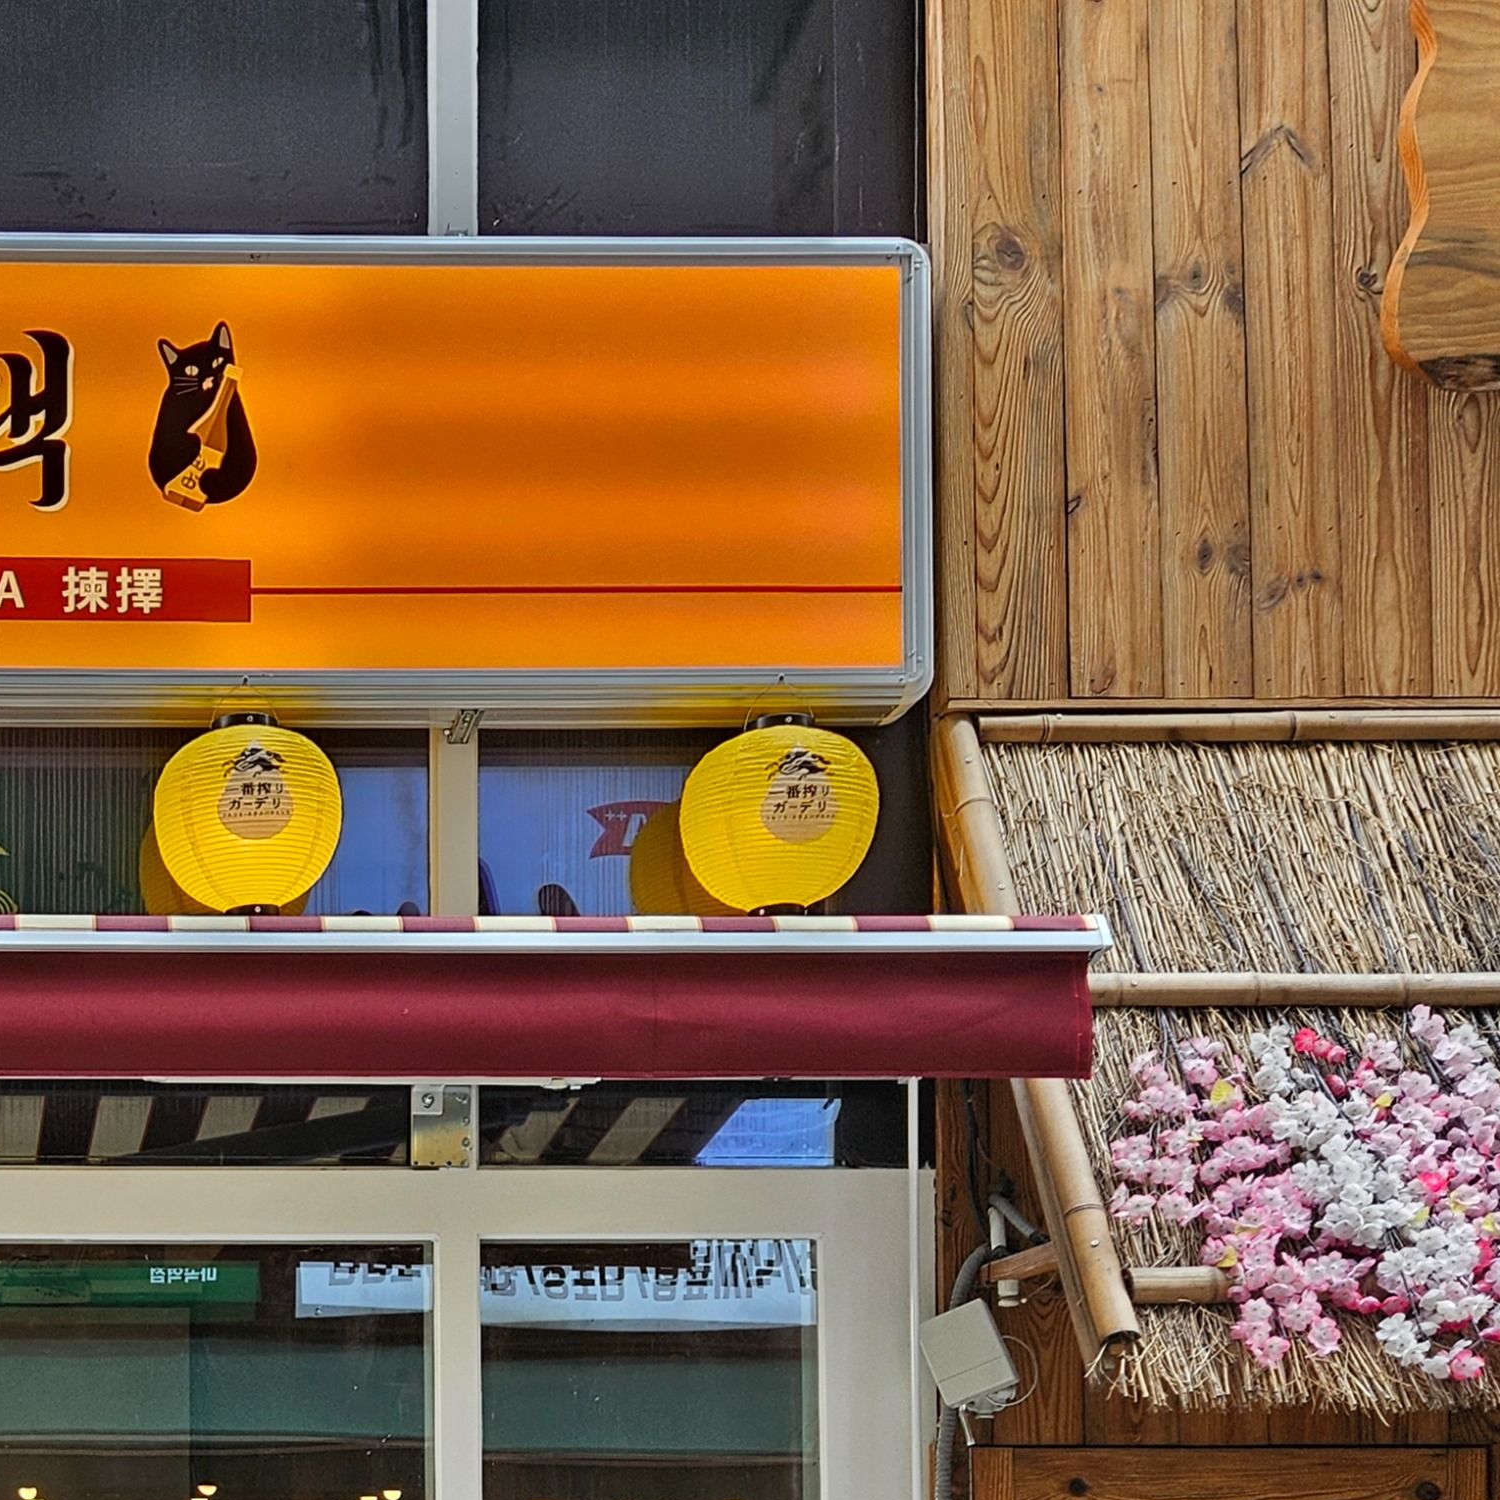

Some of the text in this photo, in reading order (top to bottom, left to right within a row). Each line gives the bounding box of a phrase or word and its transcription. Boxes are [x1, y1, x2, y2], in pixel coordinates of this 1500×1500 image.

[61, 566, 165, 614] 揀擇
[225, 781, 284, 796] 一番搾り
[768, 784, 830, 799] 一番搾り
